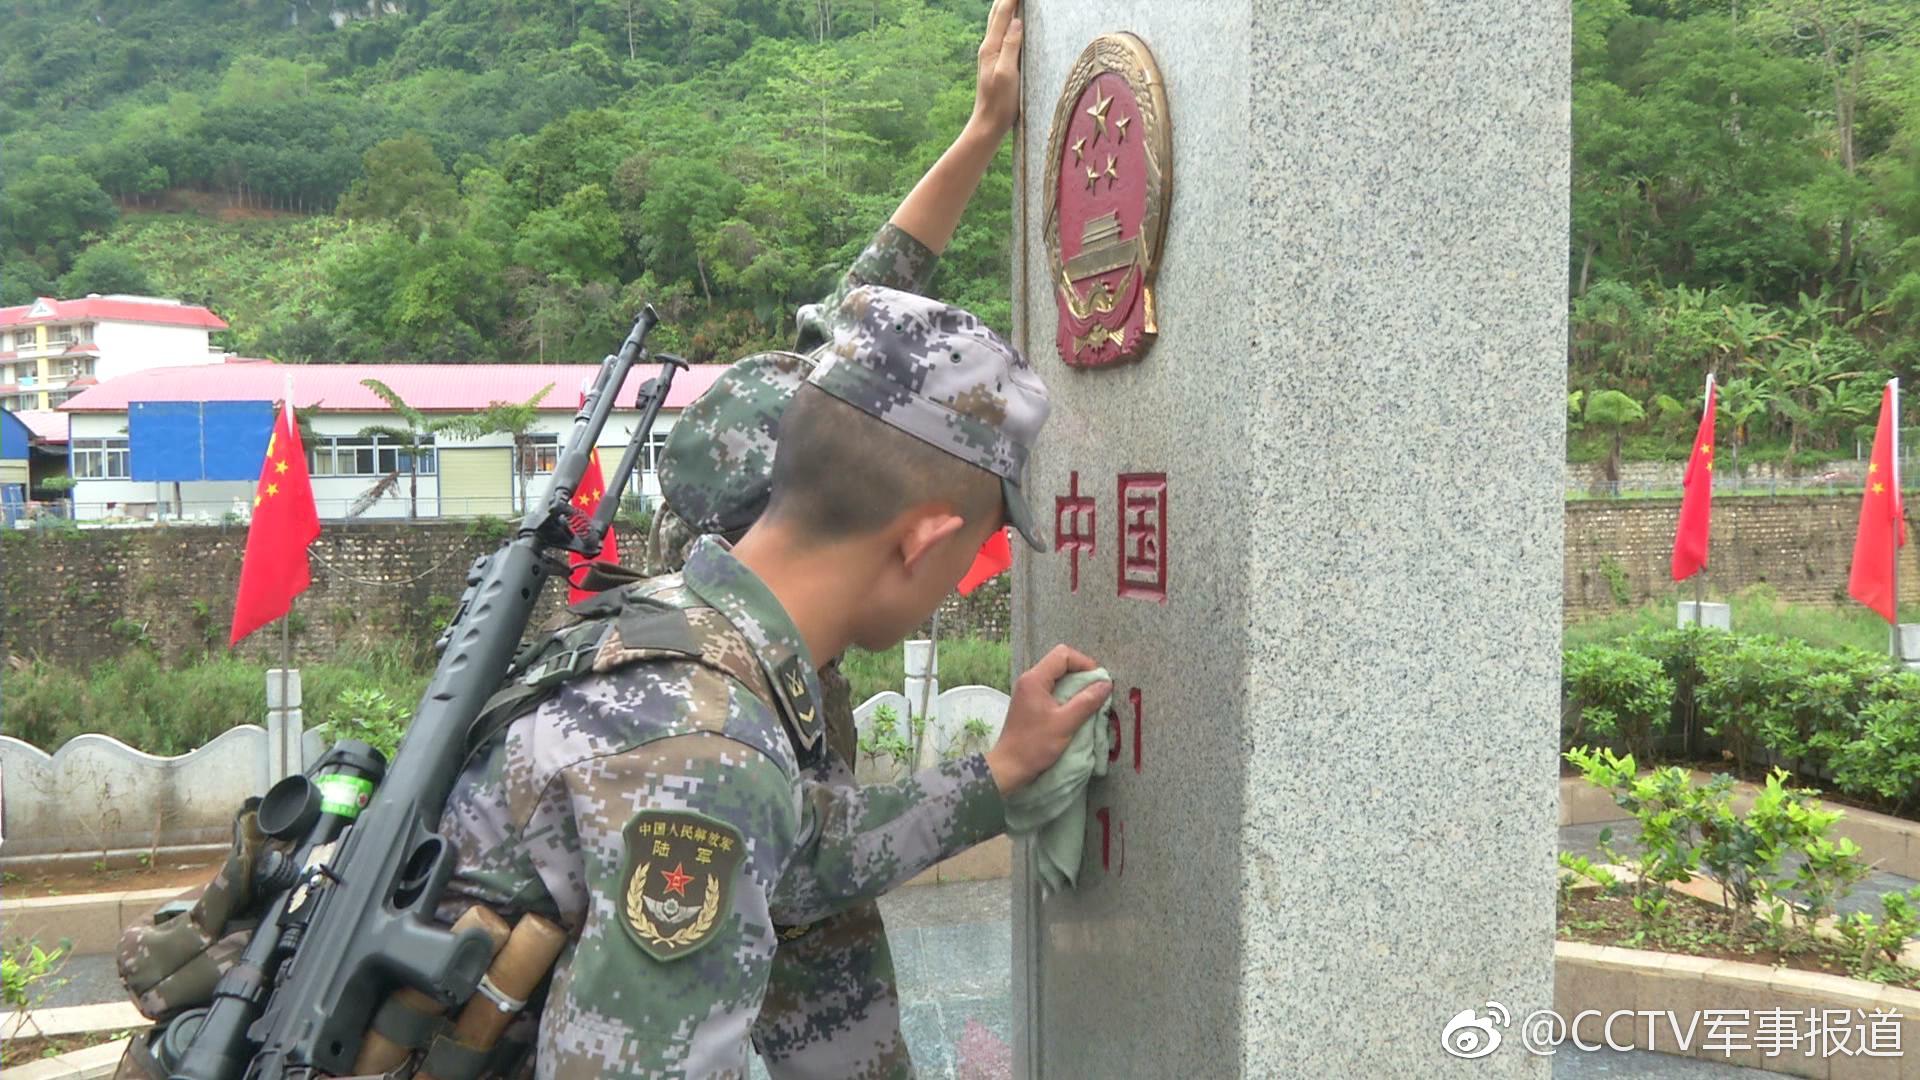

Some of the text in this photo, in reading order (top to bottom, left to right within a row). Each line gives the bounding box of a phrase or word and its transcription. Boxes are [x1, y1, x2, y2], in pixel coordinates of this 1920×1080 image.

[1055, 471, 1166, 602] 中国
[639, 821, 735, 852] 中国人民解放军
